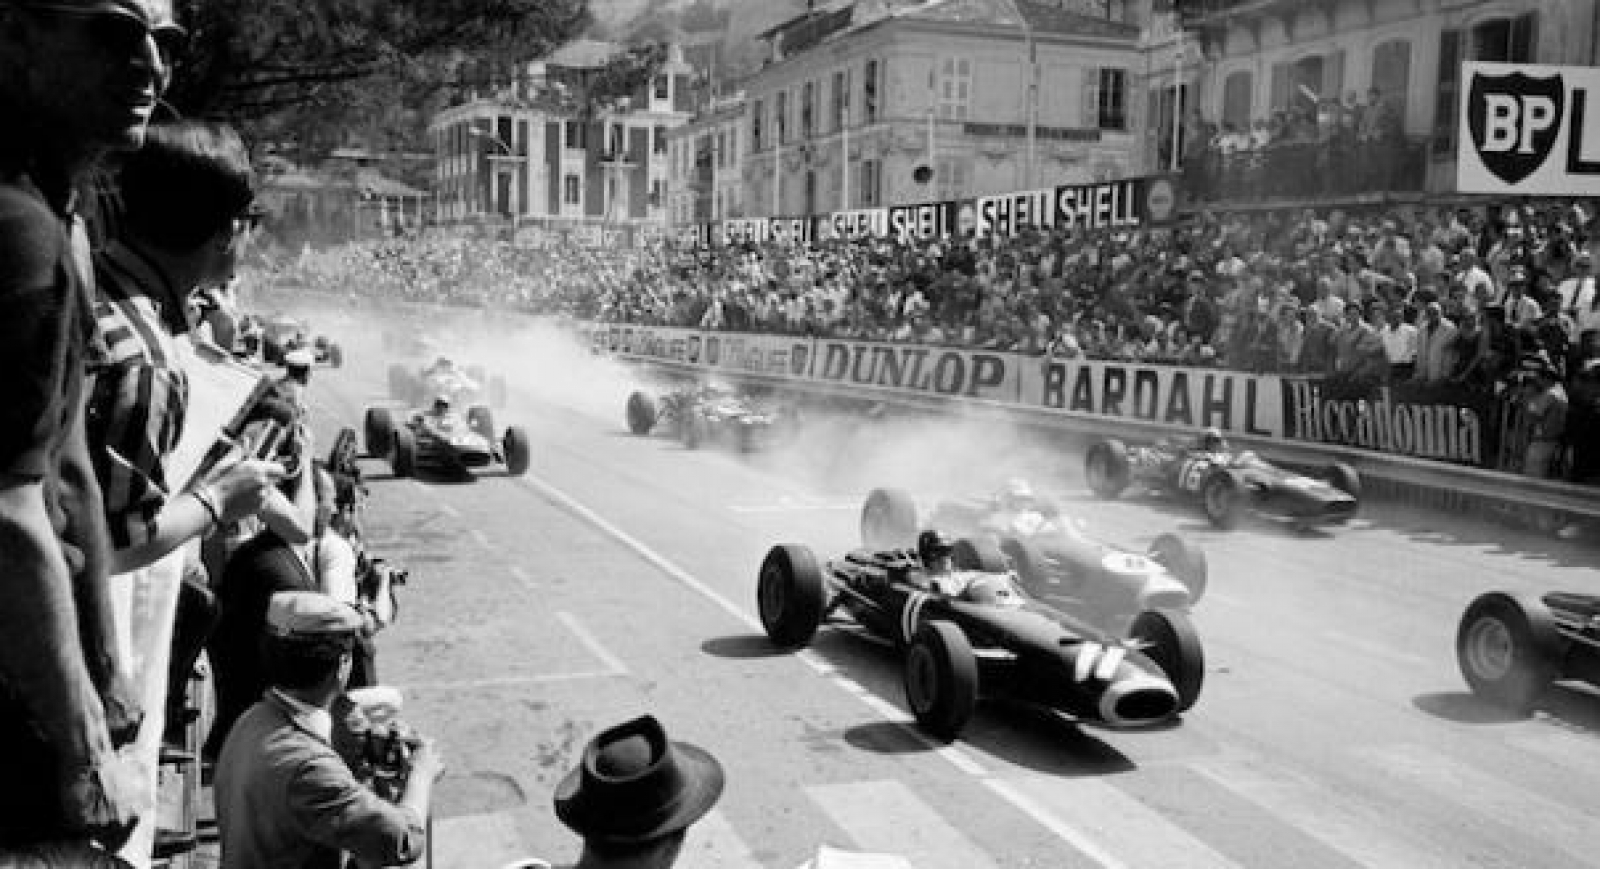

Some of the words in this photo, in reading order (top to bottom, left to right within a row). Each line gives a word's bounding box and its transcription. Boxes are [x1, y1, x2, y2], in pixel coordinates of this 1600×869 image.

[1481, 92, 1556, 154] BP
[891, 205, 950, 243] SHELL
[978, 190, 1054, 238] SHELL
[1059, 182, 1139, 229] SHELL
[824, 343, 1005, 397] DUNLOP
[1043, 362, 1272, 437] BARDAHL
